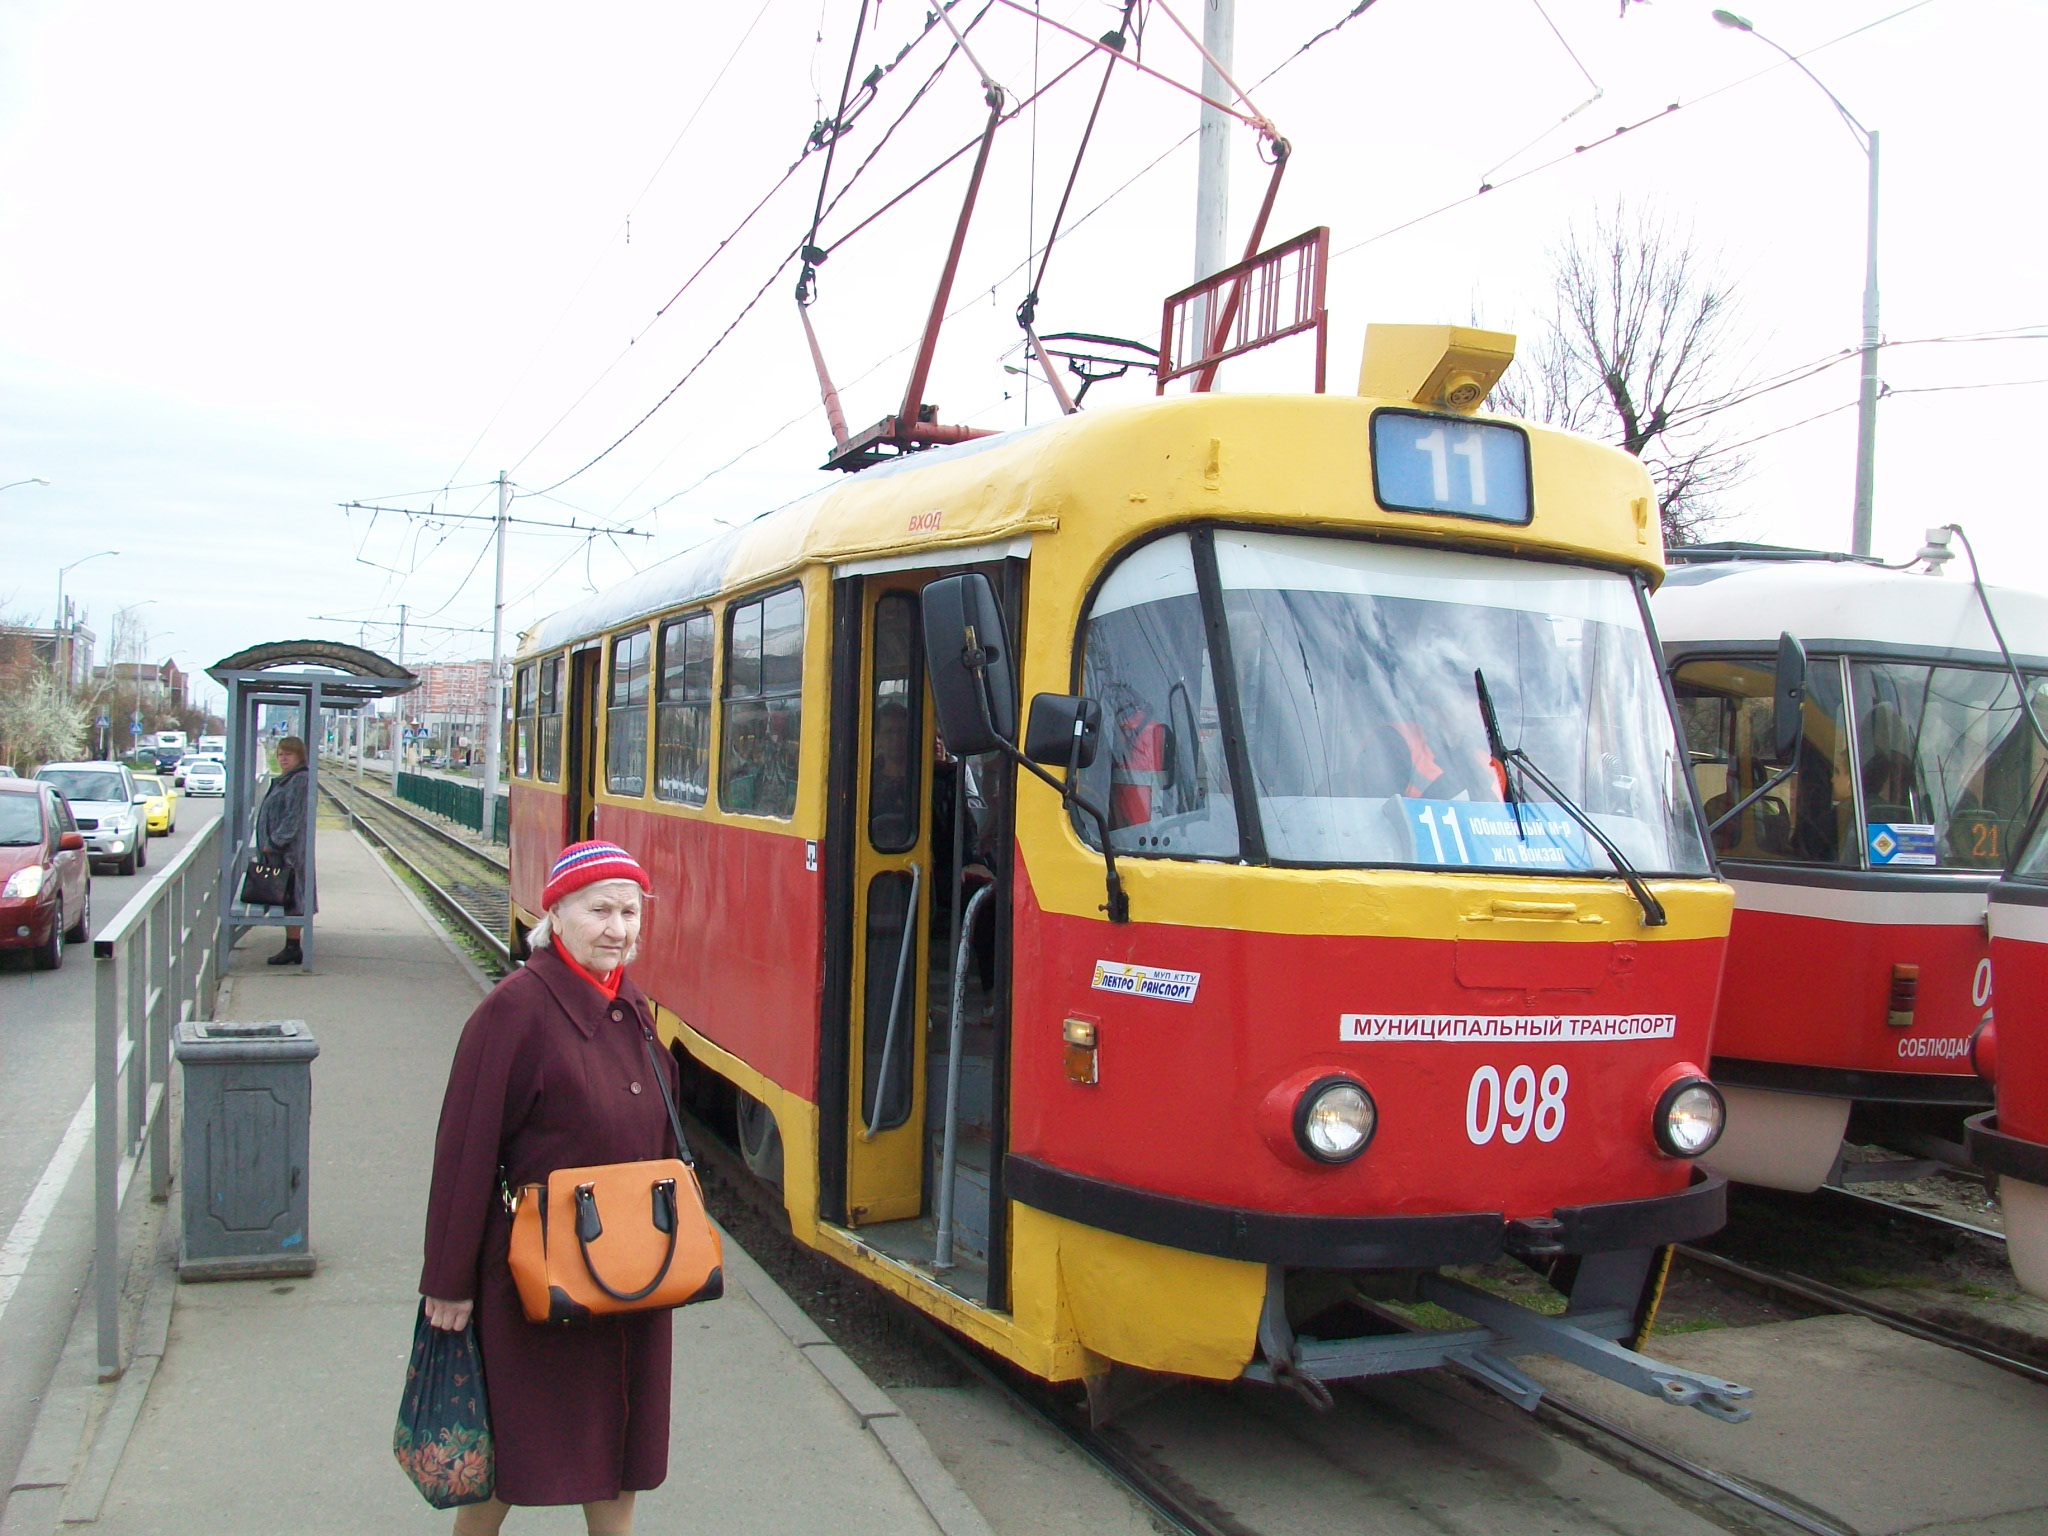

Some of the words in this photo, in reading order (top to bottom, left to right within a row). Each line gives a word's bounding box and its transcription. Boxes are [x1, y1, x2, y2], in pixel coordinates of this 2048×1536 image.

[1415, 428, 1486, 506] 11
[908, 511, 942, 532] ВХОД
[1418, 805, 1470, 864] 11
[1549, 821, 1571, 839] м-р
[1972, 823, 2000, 857] 21
[1492, 845, 1516, 864] ж/д
[1520, 844, 1566, 863] Вокзал
[1153, 970, 1171, 980] МУП
[1174, 974, 1197, 983] КТТУ
[1353, 1015, 1563, 1039] МУНИЦИПАЛЬНЫЙ
[1569, 1016, 1674, 1037] ТРАНСПОРТ
[1465, 1063, 1569, 1145] 098
